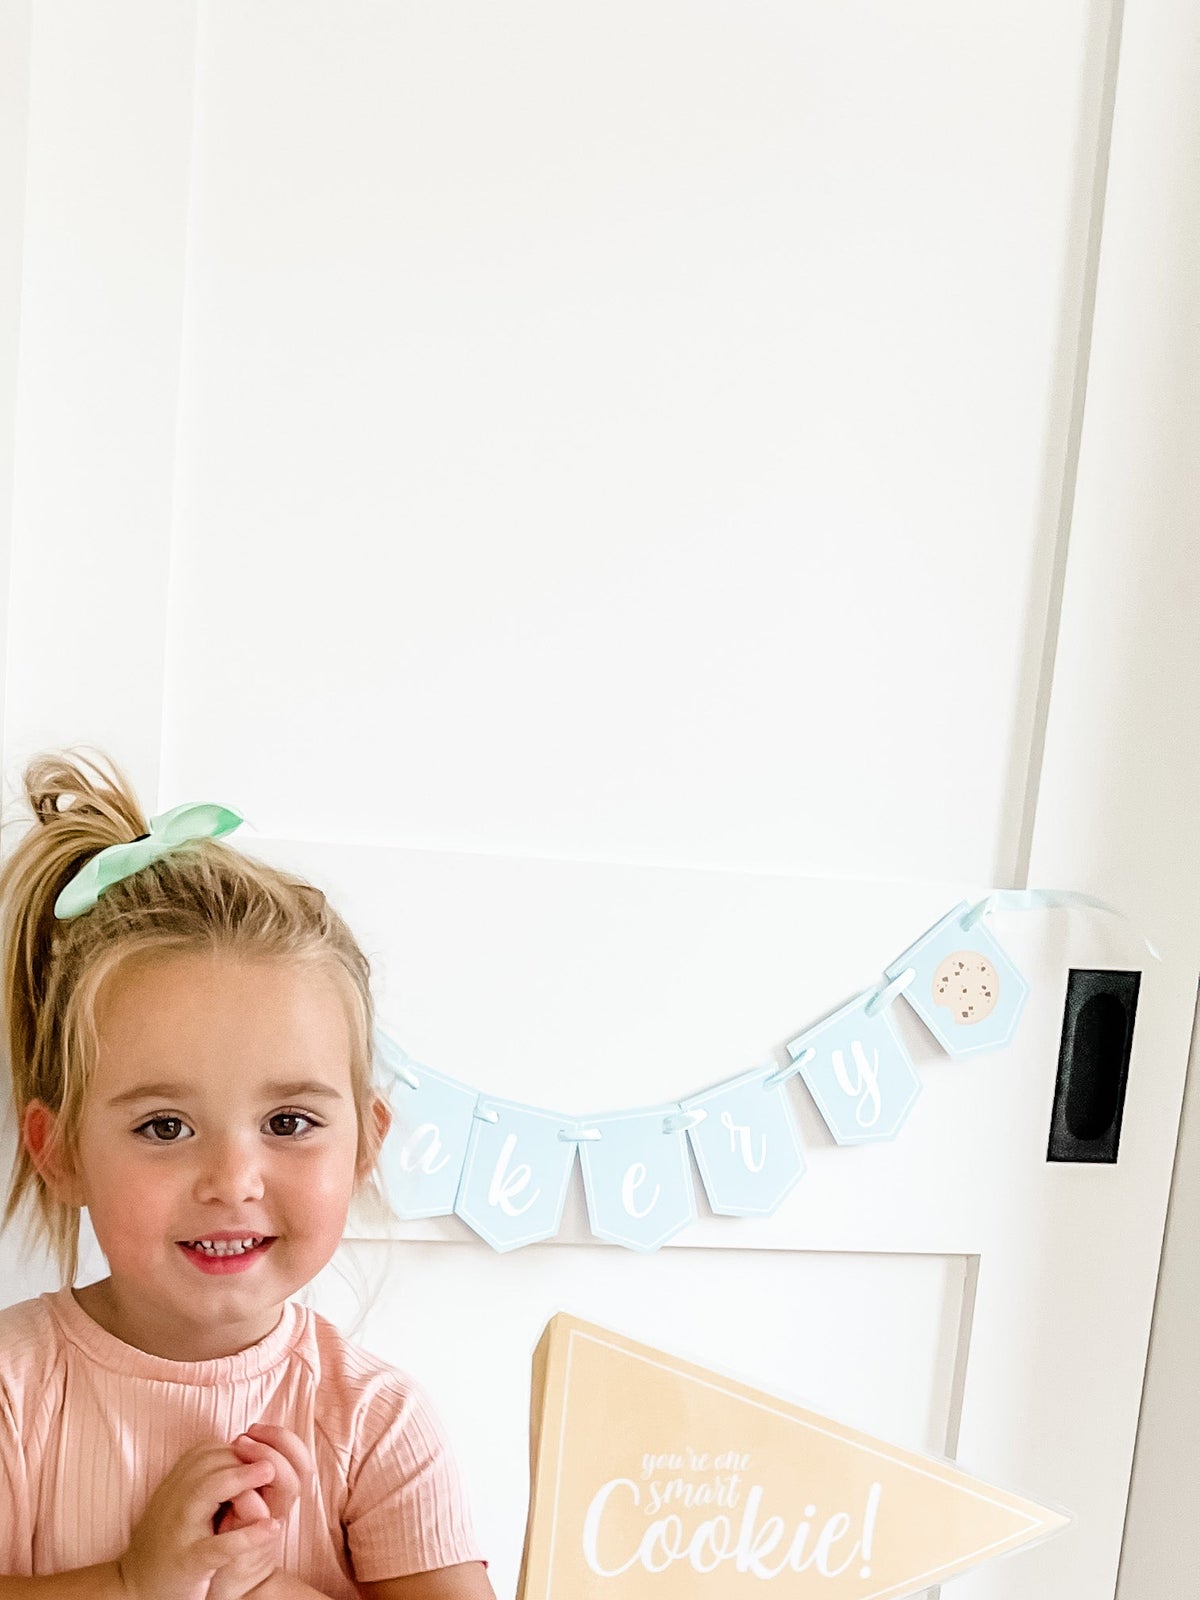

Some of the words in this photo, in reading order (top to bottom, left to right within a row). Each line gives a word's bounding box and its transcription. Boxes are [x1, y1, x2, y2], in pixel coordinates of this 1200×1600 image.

[714, 1450, 752, 1472] one
[644, 1474, 742, 1515] smart
[582, 1477, 882, 1580] Cookie!
